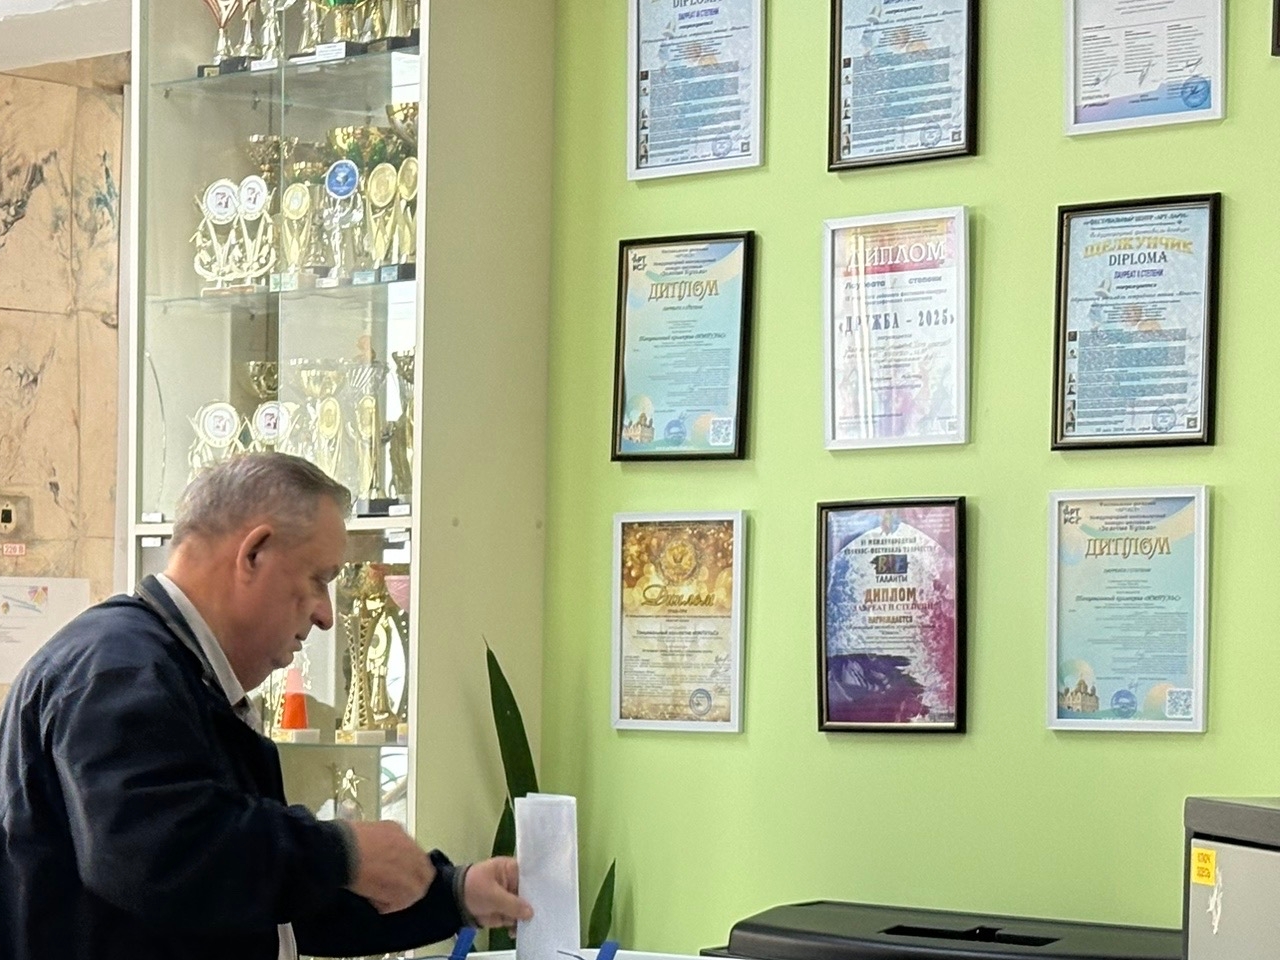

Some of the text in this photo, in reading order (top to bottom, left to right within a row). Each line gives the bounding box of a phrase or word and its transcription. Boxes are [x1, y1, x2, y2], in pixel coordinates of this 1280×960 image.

[848, 240, 945, 272] ДИПЛОМ
[1109, 251, 1167, 266] DIPLOMA
[648, 280, 720, 302] ДИПЛОМ
[1085, 537, 1171, 559] ДИПЛОМ
[864, 587, 917, 603] ДИПЛОМ
